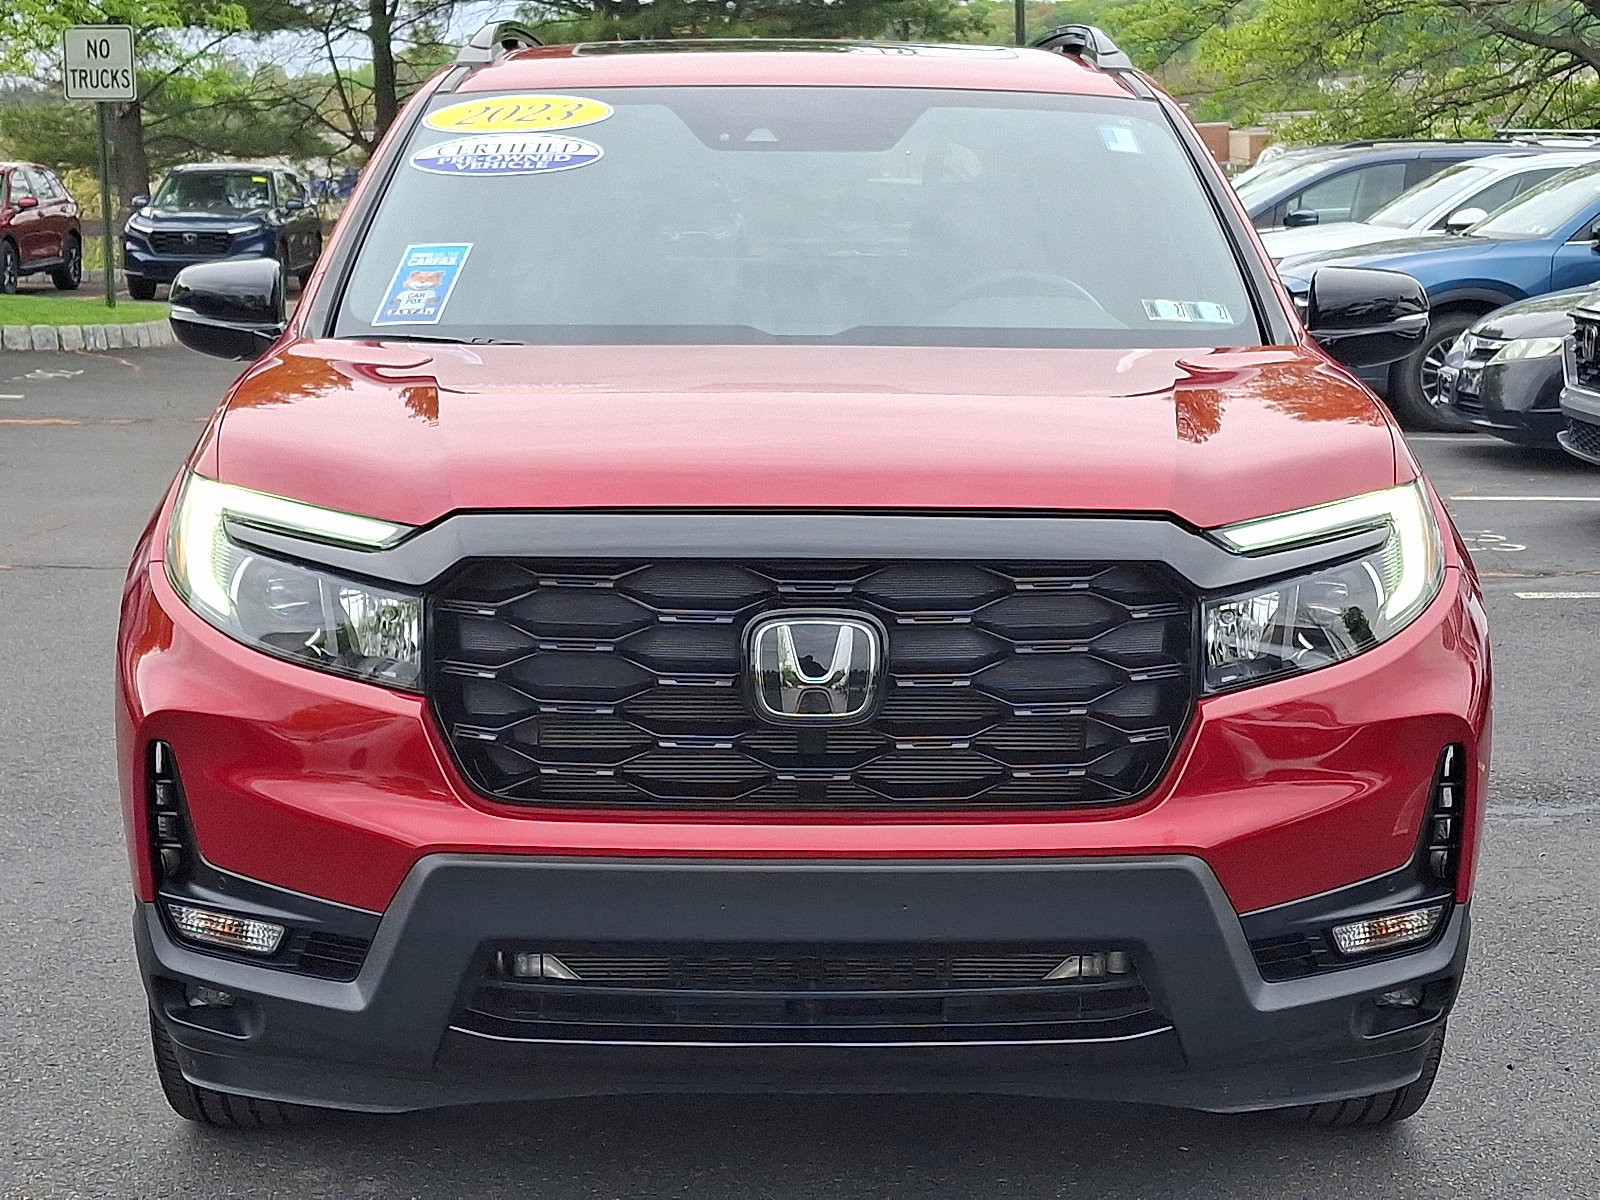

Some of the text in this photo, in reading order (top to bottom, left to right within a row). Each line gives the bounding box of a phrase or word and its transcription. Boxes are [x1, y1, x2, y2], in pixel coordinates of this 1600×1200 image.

[87, 38, 110, 59] NO
[69, 68, 131, 89] TRUCKS
[454, 103, 584, 126] 2023
[437, 143, 582, 156] CERTIFIED
[437, 154, 572, 165] PRE-OWNED
[456, 161, 550, 170] VEHICLE
[407, 256, 459, 267] CARFAX
